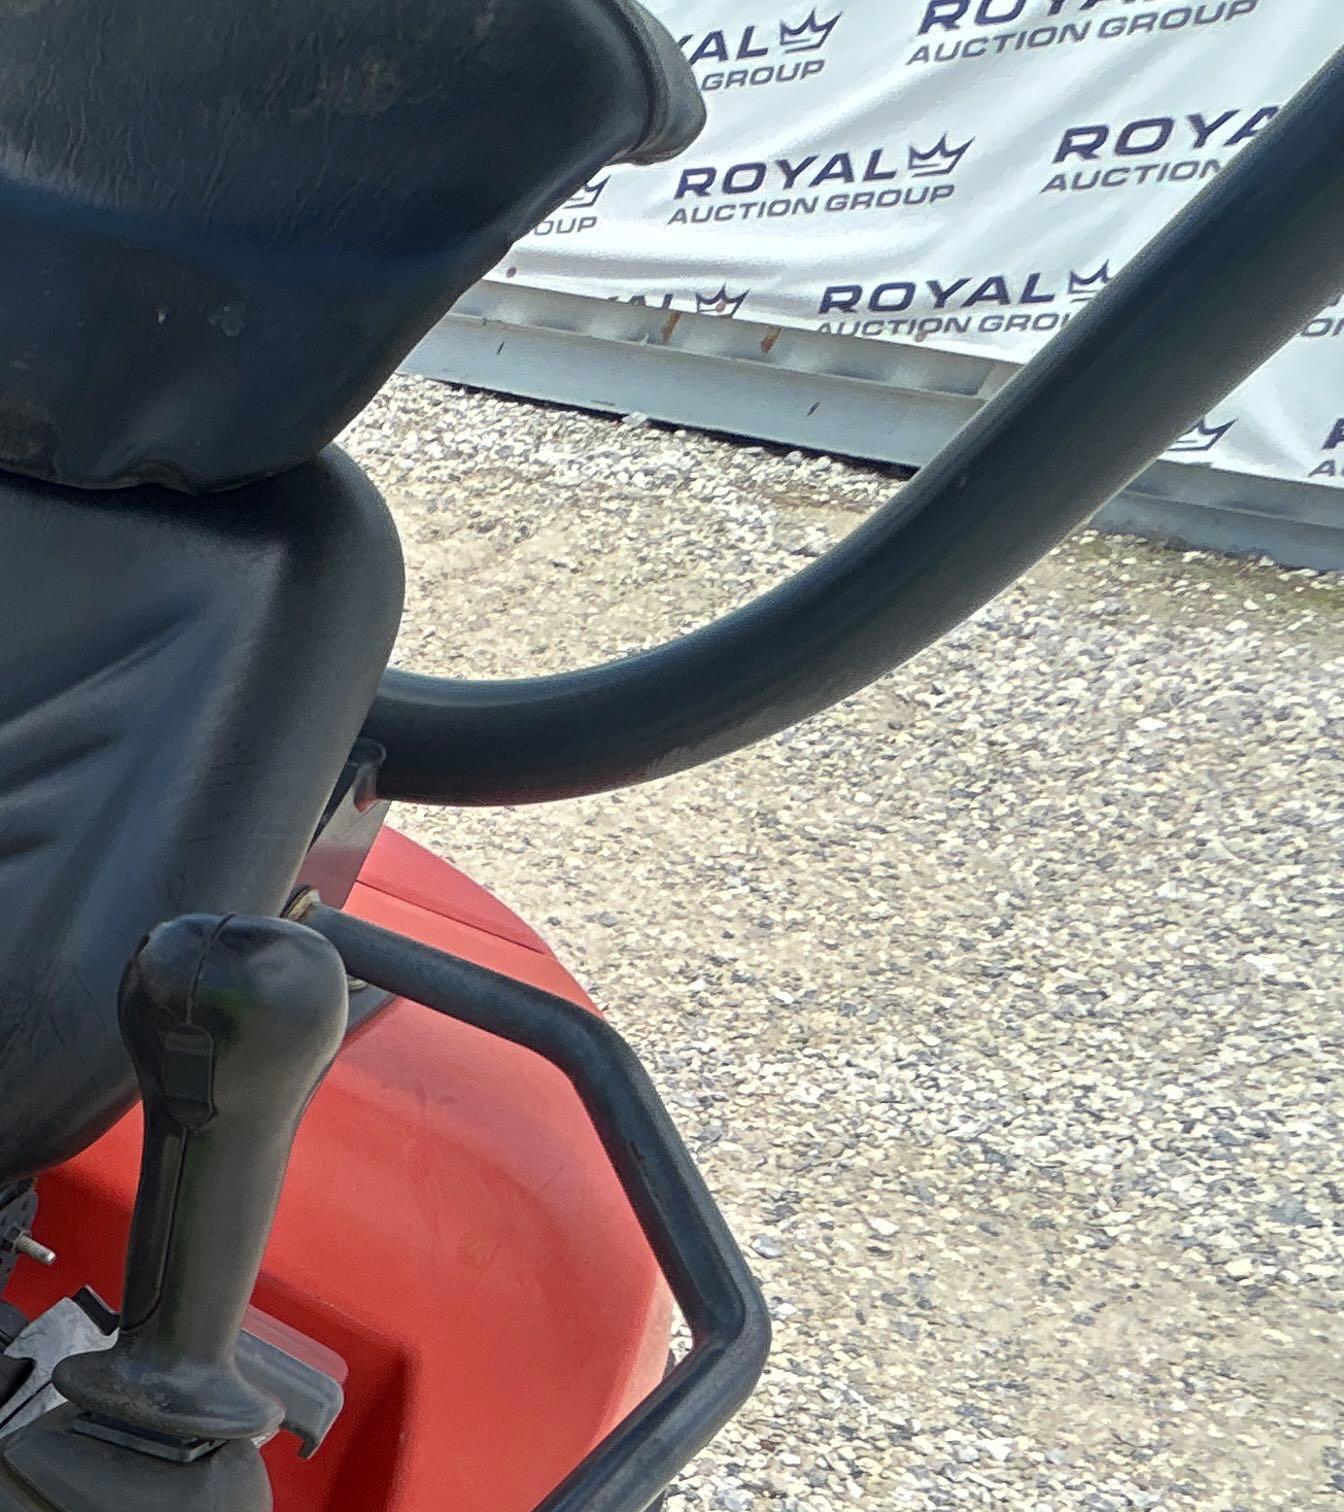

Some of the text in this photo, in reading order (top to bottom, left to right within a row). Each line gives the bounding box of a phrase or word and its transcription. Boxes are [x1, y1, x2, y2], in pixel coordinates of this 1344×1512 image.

[905, 21, 1091, 65] AUCTION
[1097, 0, 1257, 39] GROUP
[701, 59, 825, 91] GROUP
[1052, 106, 1279, 164] ROYA
[674, 149, 898, 200] ROYAL
[667, 184, 955, 225] AUCTION GROUP
[534, 216, 597, 236] OUP
[818, 272, 1055, 314] ROYAL
[817, 312, 1071, 336] AUCTION GRO
